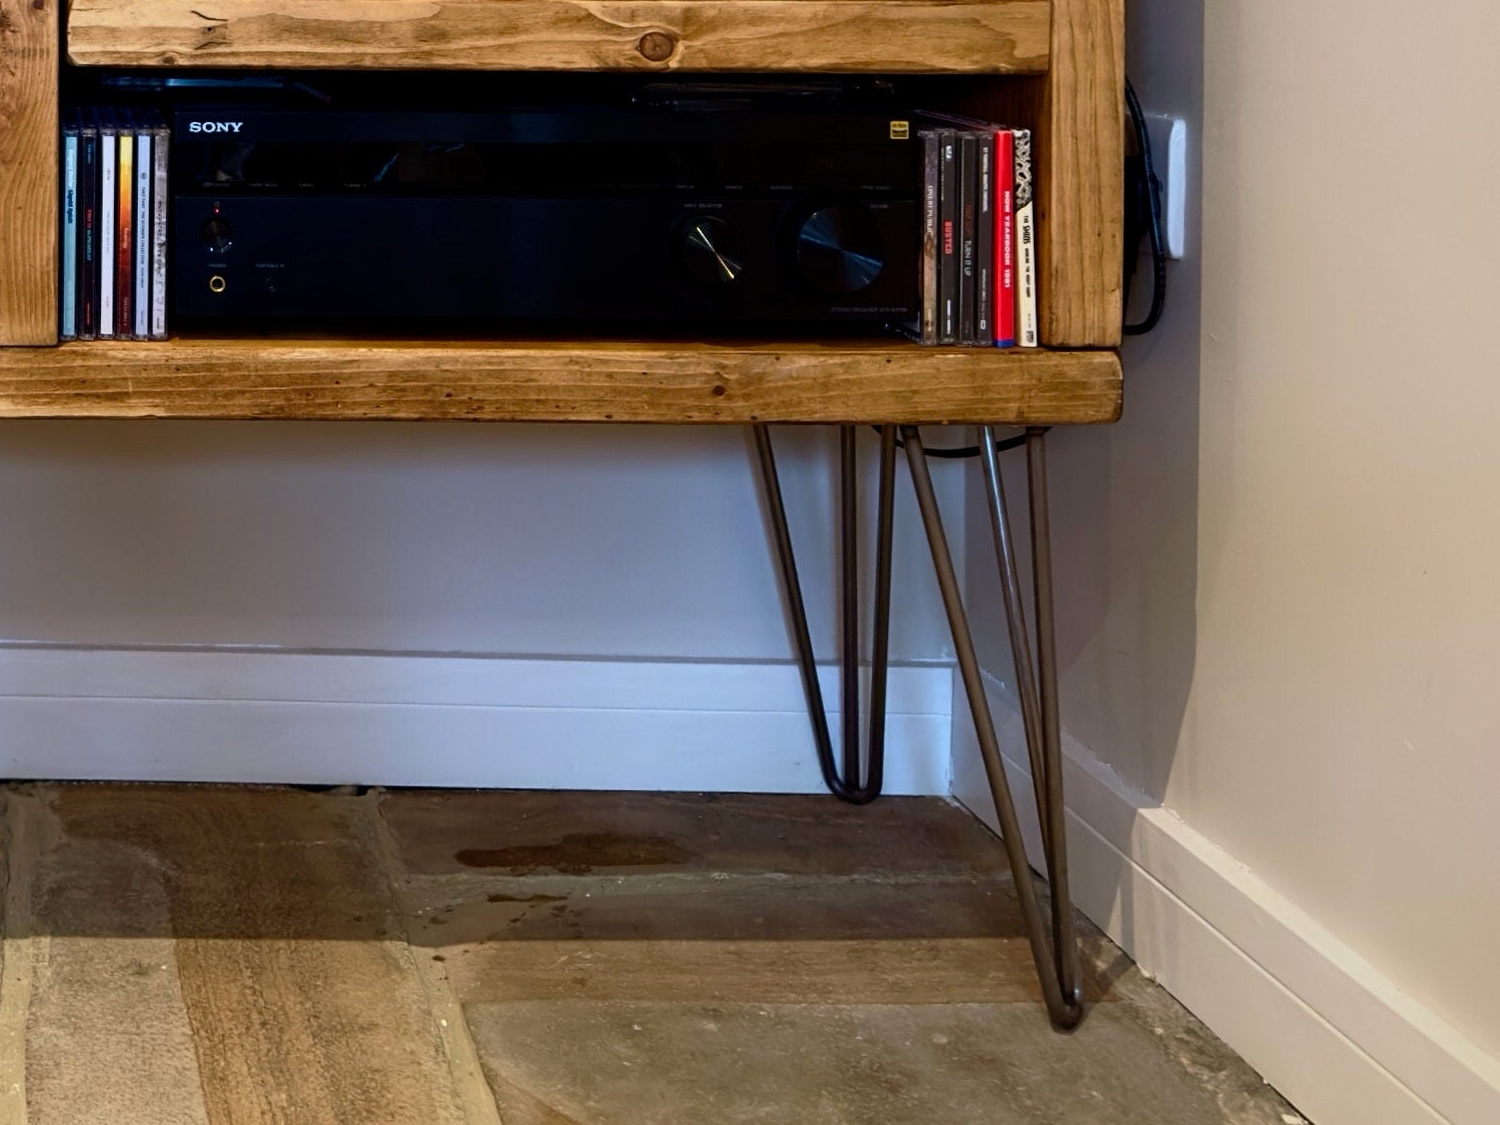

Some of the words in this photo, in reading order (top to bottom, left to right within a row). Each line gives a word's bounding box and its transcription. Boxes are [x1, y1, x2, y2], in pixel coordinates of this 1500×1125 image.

[189, 121, 243, 133] SONY
[1022, 225, 1030, 244] SHINS
[964, 268, 971, 276] UP
